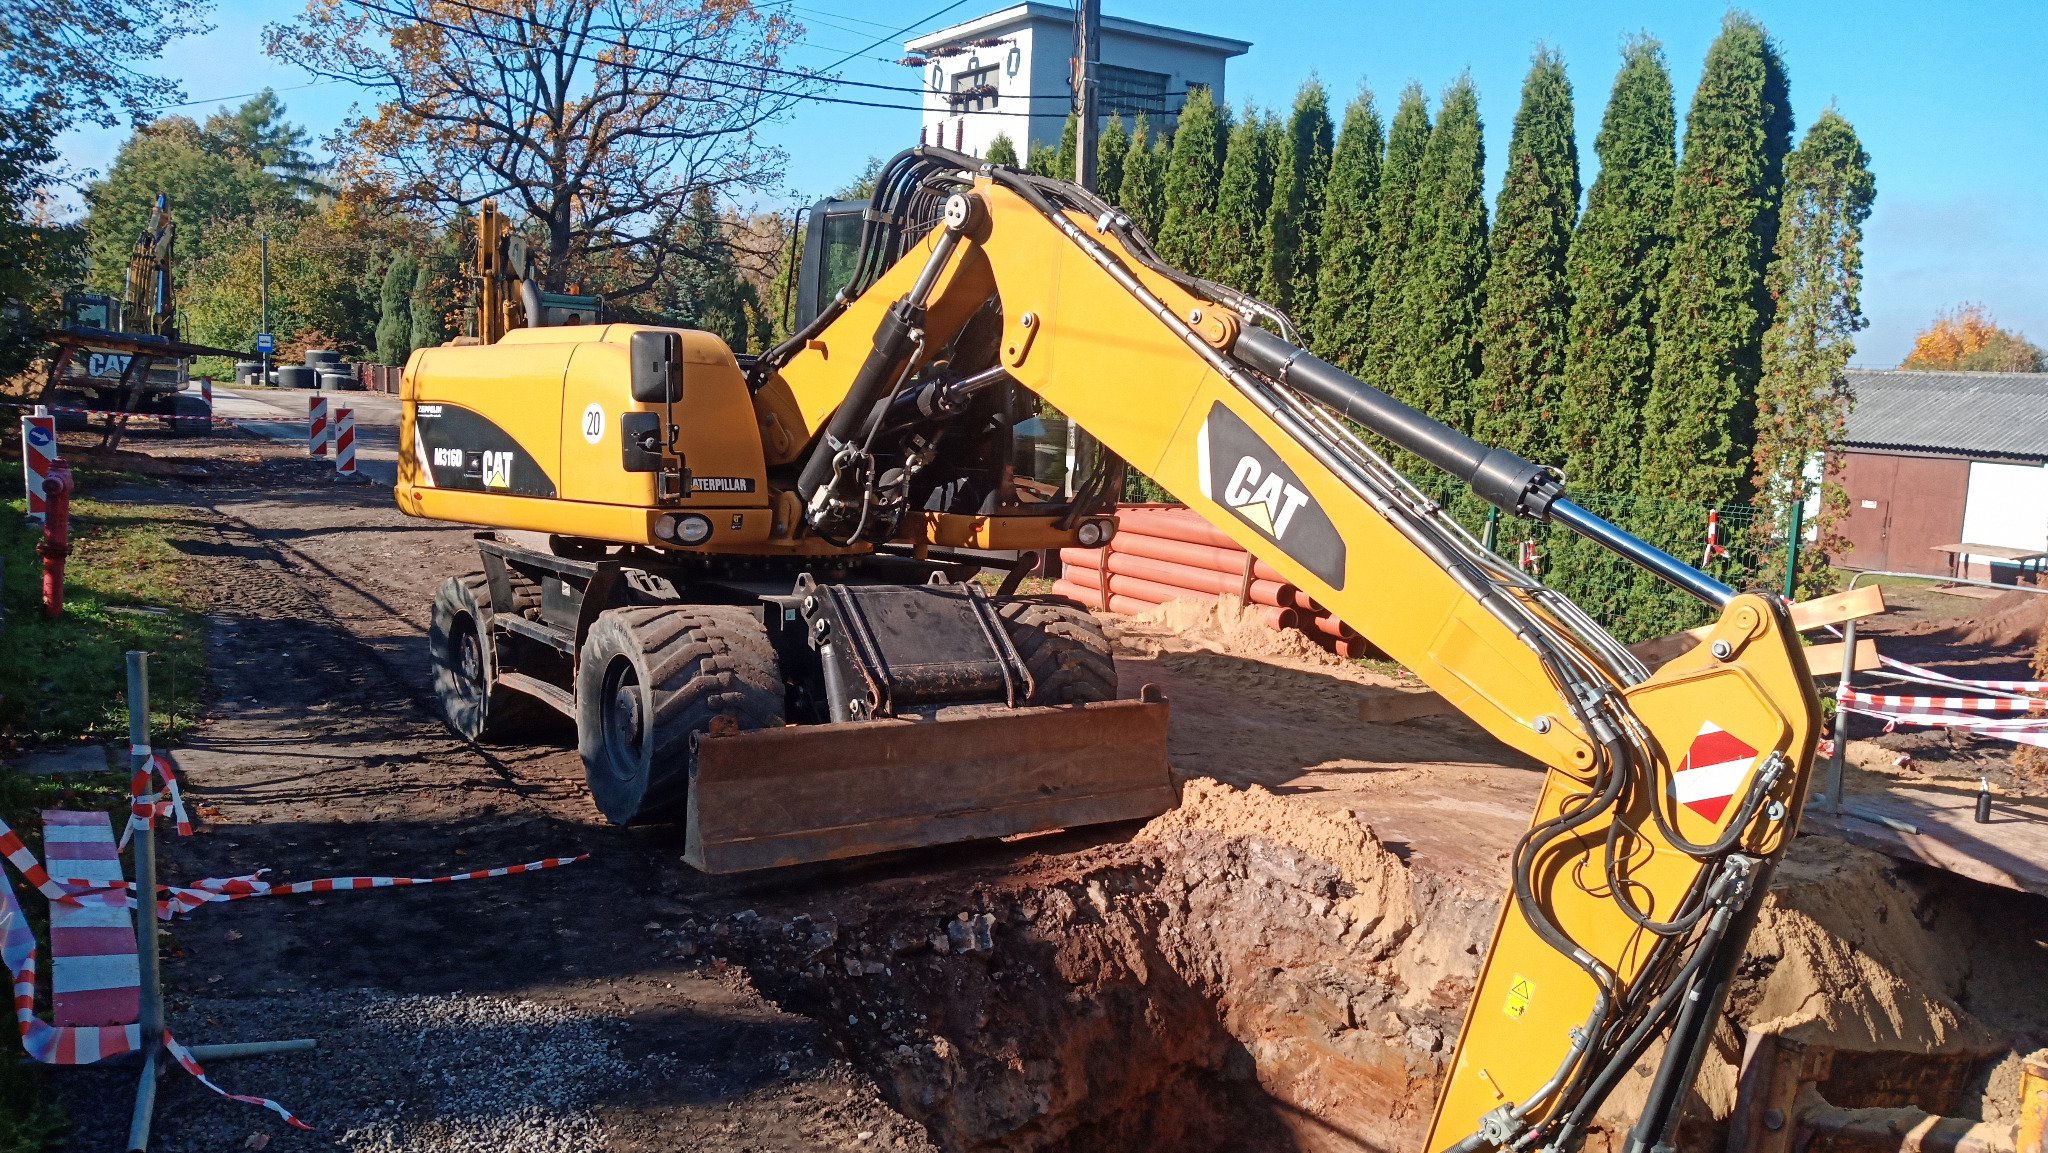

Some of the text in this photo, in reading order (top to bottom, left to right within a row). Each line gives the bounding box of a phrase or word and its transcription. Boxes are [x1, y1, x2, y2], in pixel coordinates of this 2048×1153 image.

[417, 405, 442, 414] ZEPPELIN
[587, 411, 600, 435] 20
[434, 448, 463, 467] M316D
[483, 450, 514, 488] CAT
[691, 478, 747, 491] ATERPILLAR
[1224, 455, 1309, 541] CAT
